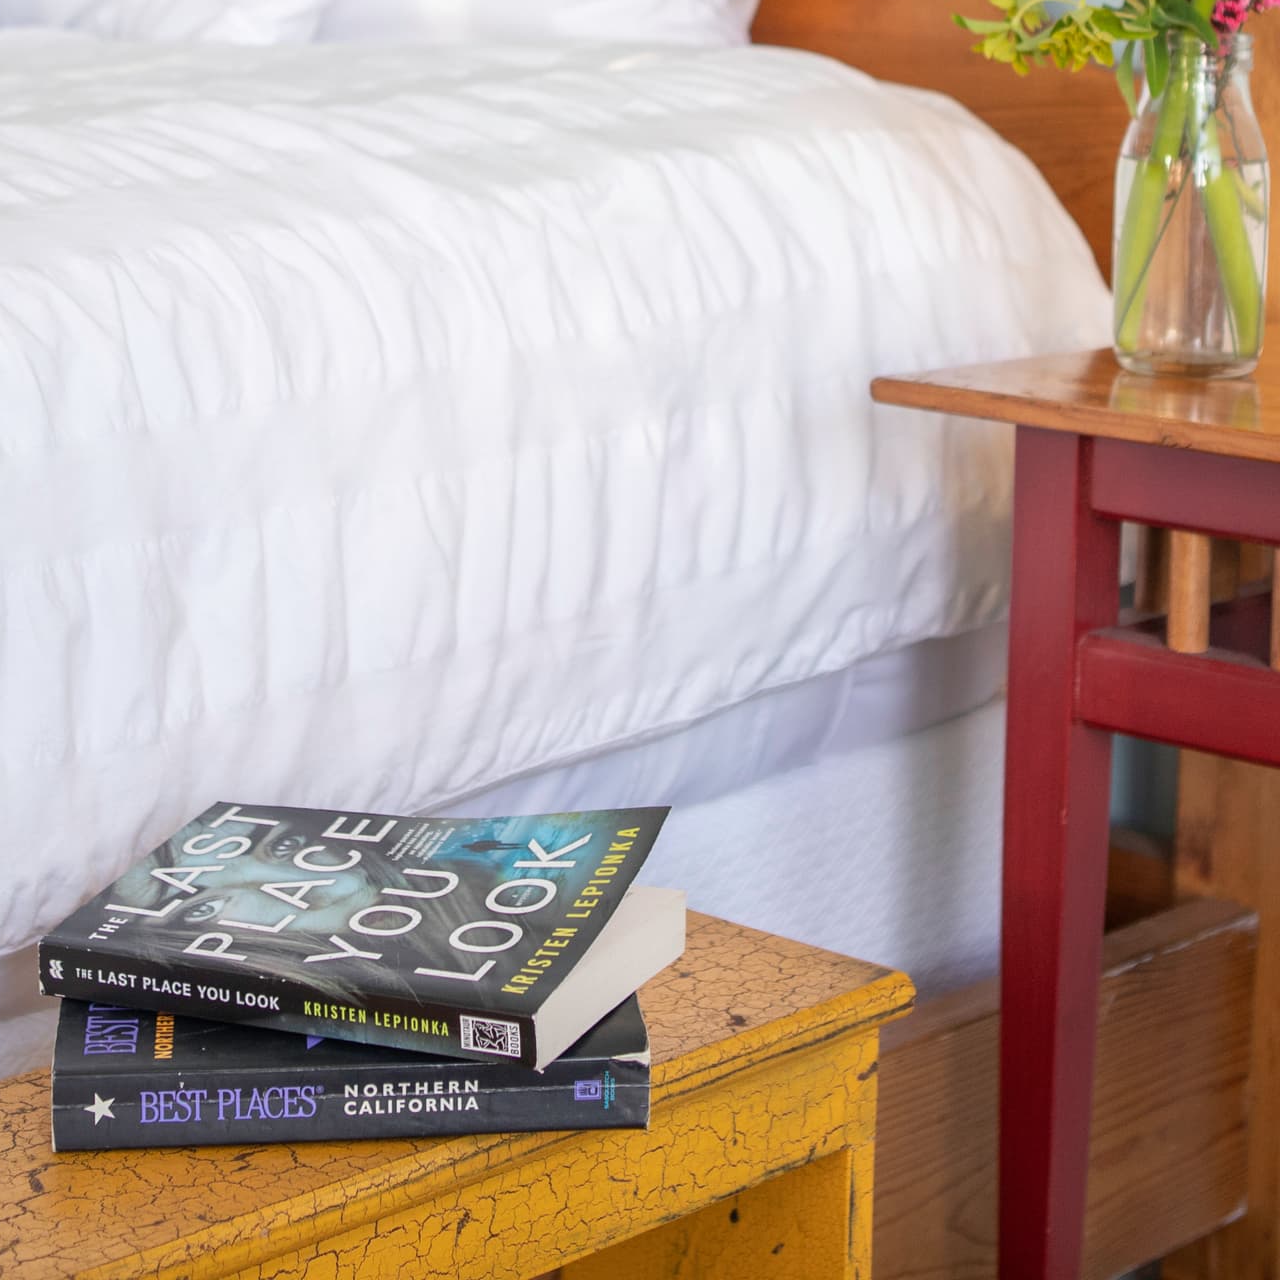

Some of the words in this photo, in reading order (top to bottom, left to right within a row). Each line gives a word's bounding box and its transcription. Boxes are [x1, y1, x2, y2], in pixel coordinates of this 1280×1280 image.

[104, 806, 281, 918] LAST
[182, 816, 399, 962] PLACE
[413, 832, 593, 982] LOOK
[88, 916, 129, 941] THE
[303, 867, 460, 963] YOU
[501, 927, 579, 995] KRISTEN
[566, 826, 641, 919] LEPIONKA
[75, 967, 93, 980] THE
[97, 969, 137, 989] LAST
[142, 977, 192, 997] PLACE
[197, 985, 231, 1003] YOU
[235, 990, 281, 1011] LOOK
[83, 1015, 140, 1056] BEST
[303, 1000, 367, 1024] KRISTEN
[374, 1011, 450, 1037] LEPIONKA
[508, 1025, 520, 1055] BOOKS
[139, 1089, 209, 1124] BEST
[343, 1079, 480, 1098] NORTHERN
[343, 1096, 480, 1116] CALIFORNIA
